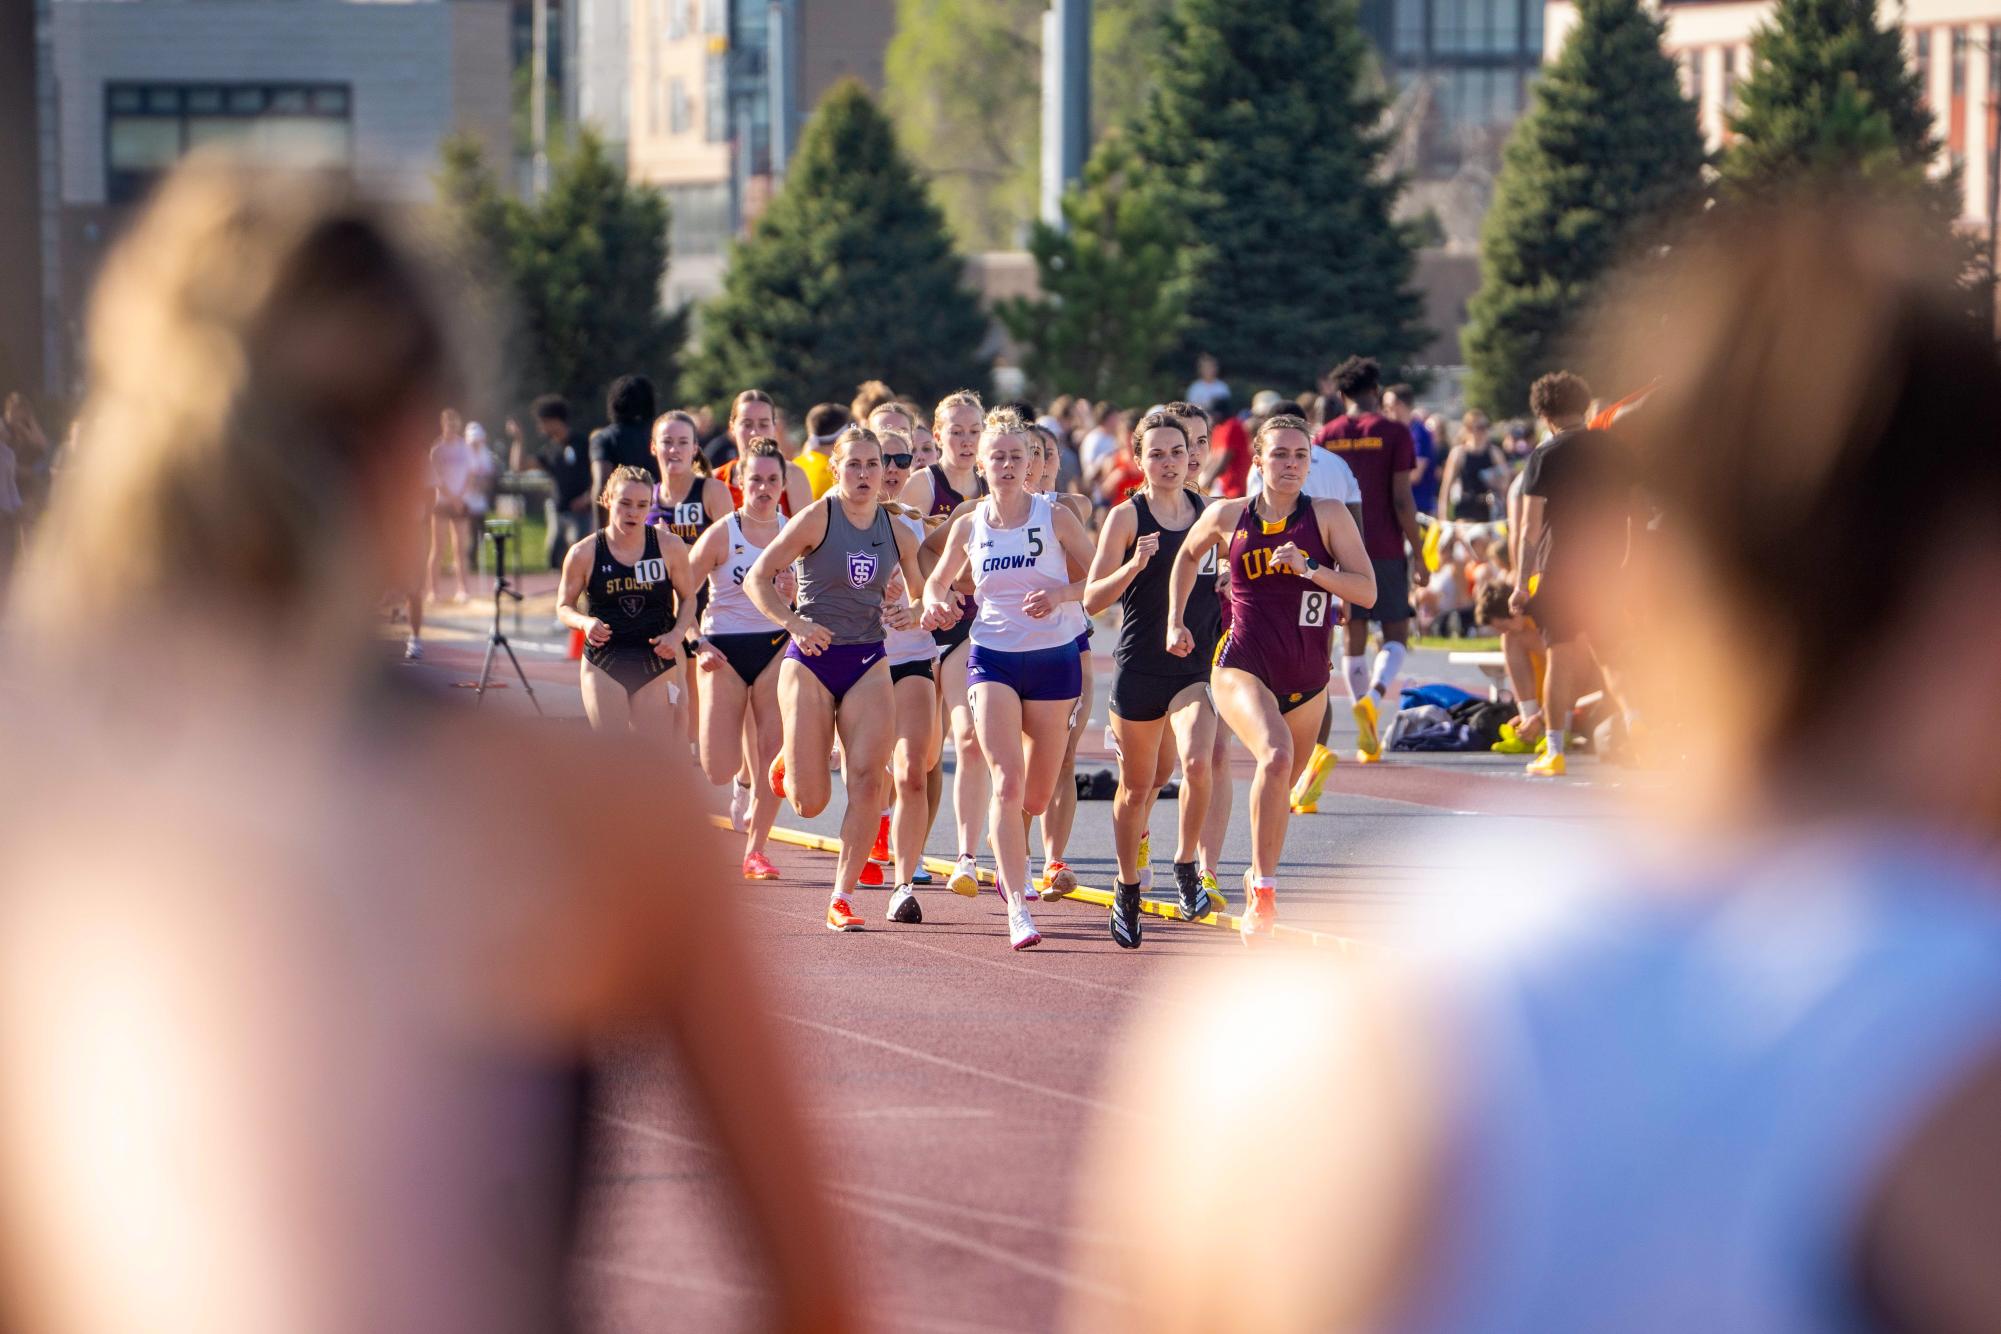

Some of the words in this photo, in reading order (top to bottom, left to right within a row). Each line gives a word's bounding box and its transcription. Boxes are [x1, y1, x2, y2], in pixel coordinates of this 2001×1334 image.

[677, 504, 699, 523] 16
[1027, 528, 1043, 557] 5
[637, 561, 660, 582] 10
[983, 555, 1036, 572] CROWN
[606, 579, 623, 594] ST.
[1306, 593, 1322, 624] 8
